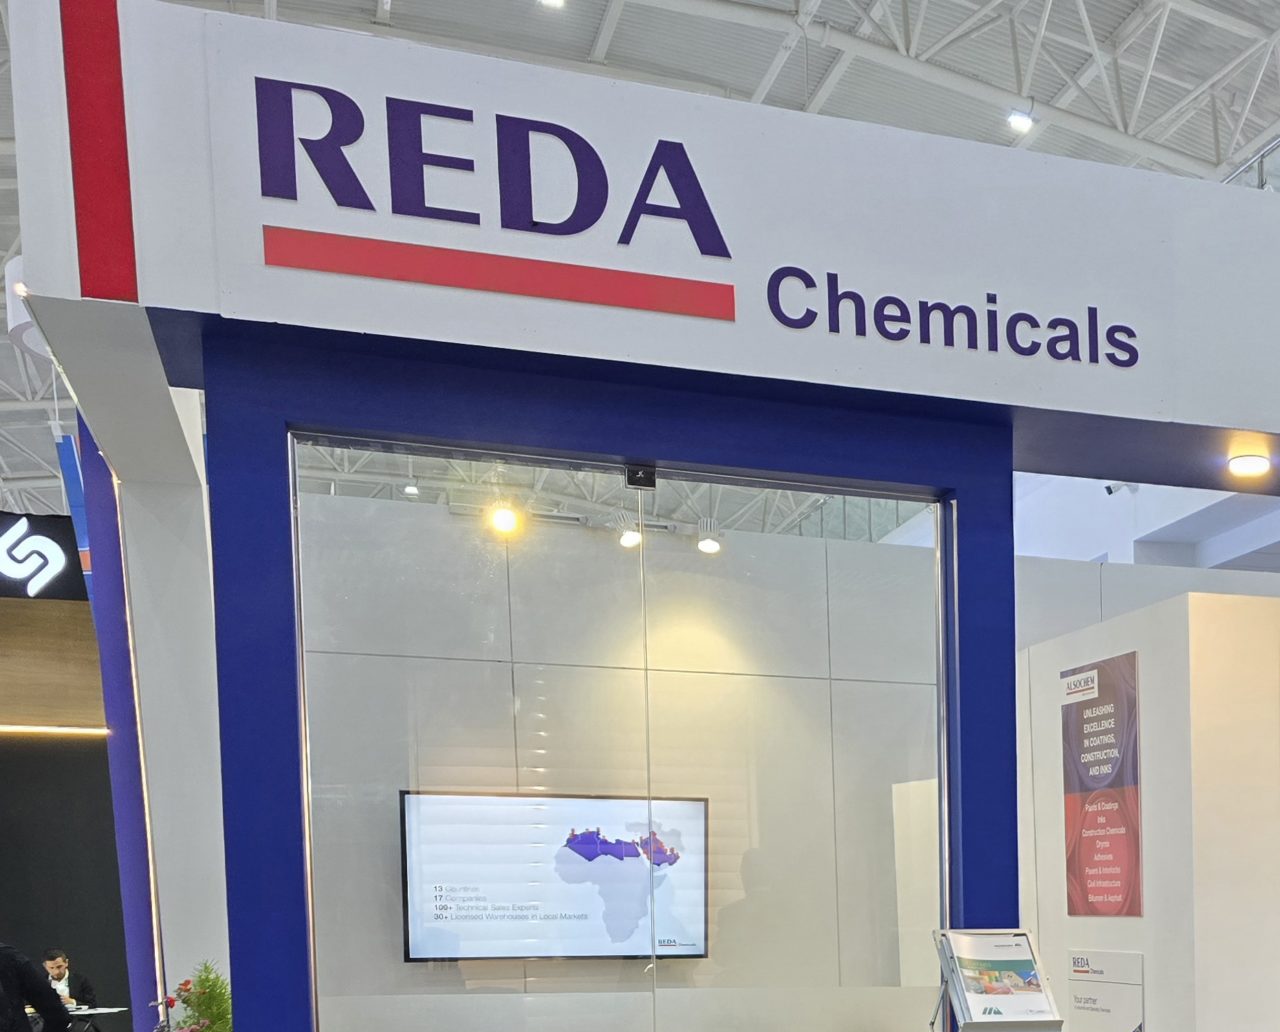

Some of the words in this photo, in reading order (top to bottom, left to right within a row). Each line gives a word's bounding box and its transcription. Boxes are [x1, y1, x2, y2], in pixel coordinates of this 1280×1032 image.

[255, 77, 732, 259] REDA
[766, 265, 1140, 368] Chemicals
[1083, 704, 1114, 718] UNLEASHING
[1084, 719, 1115, 733] EXCELLENCE
[1089, 766, 1100, 776] AND
[1100, 764, 1112, 774] INKS
[1072, 957, 1090, 968] REDA
